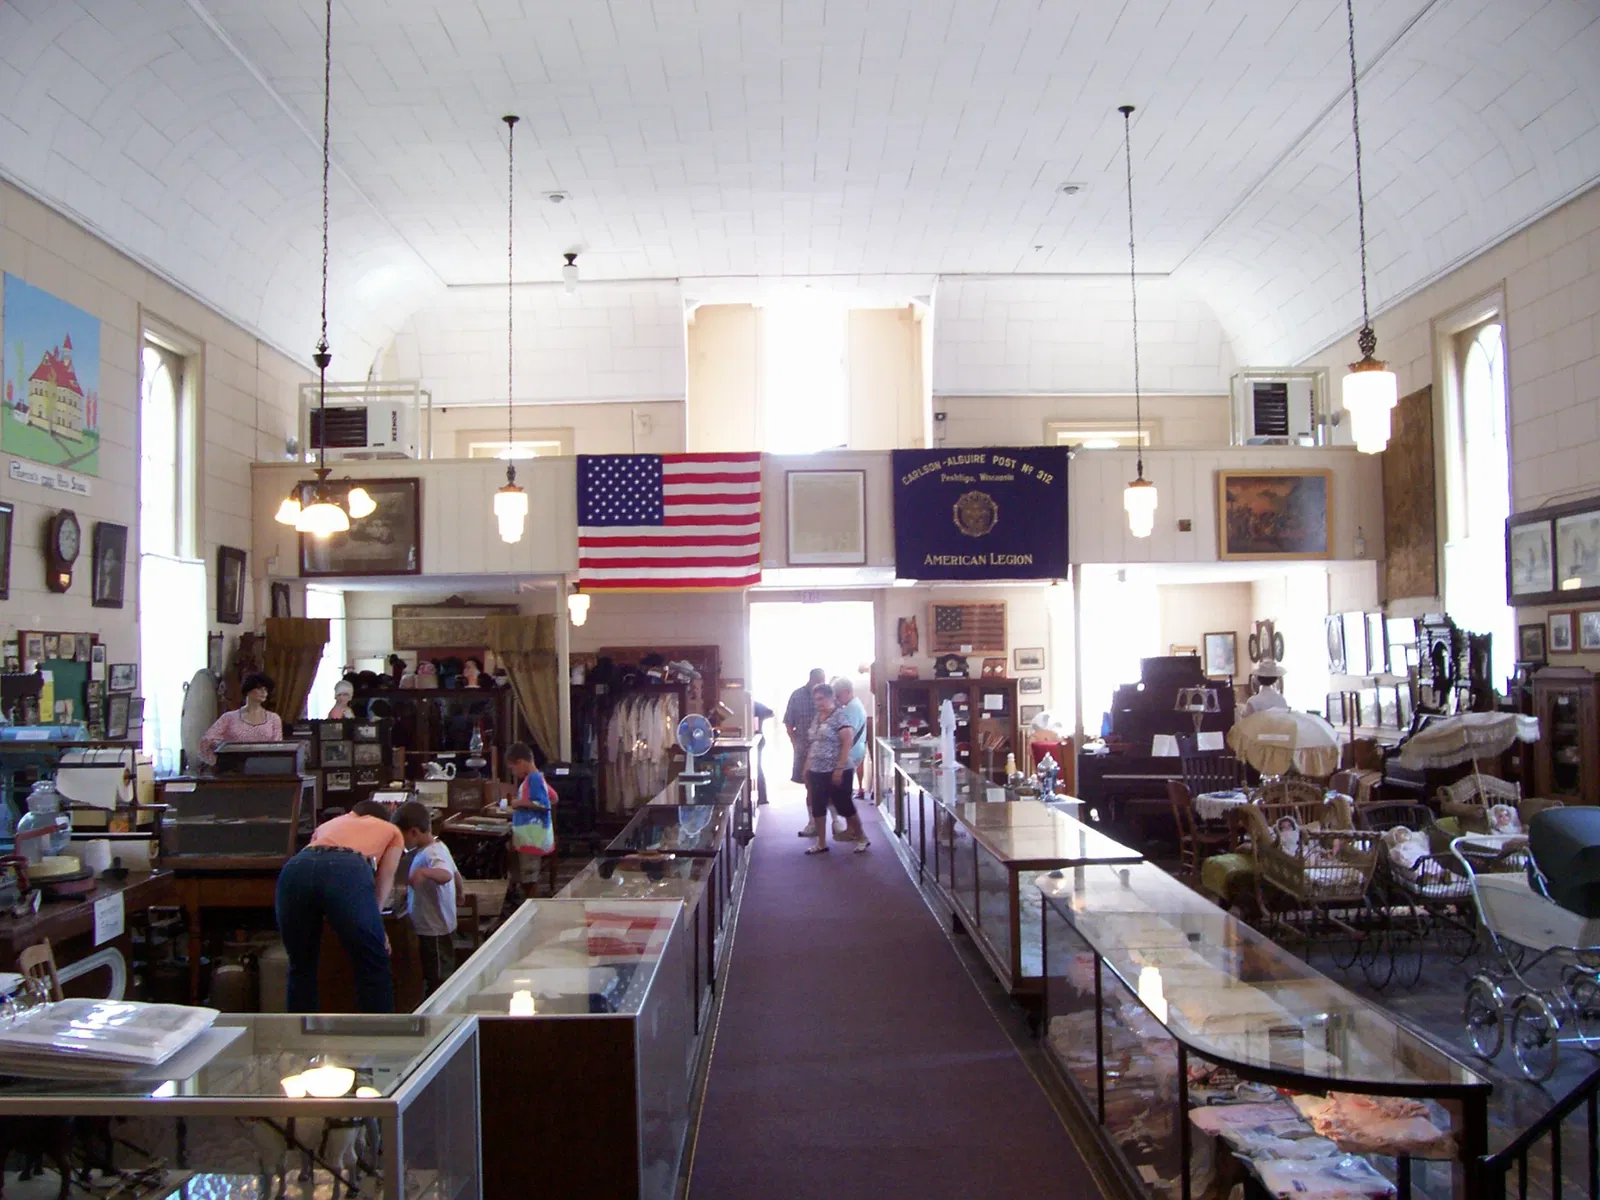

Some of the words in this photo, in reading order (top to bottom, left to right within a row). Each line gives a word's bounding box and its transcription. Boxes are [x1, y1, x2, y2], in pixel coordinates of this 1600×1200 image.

[993, 455, 1017, 469] POST
[1036, 470, 1053, 484] 312
[990, 552, 1033, 564] LEGION
